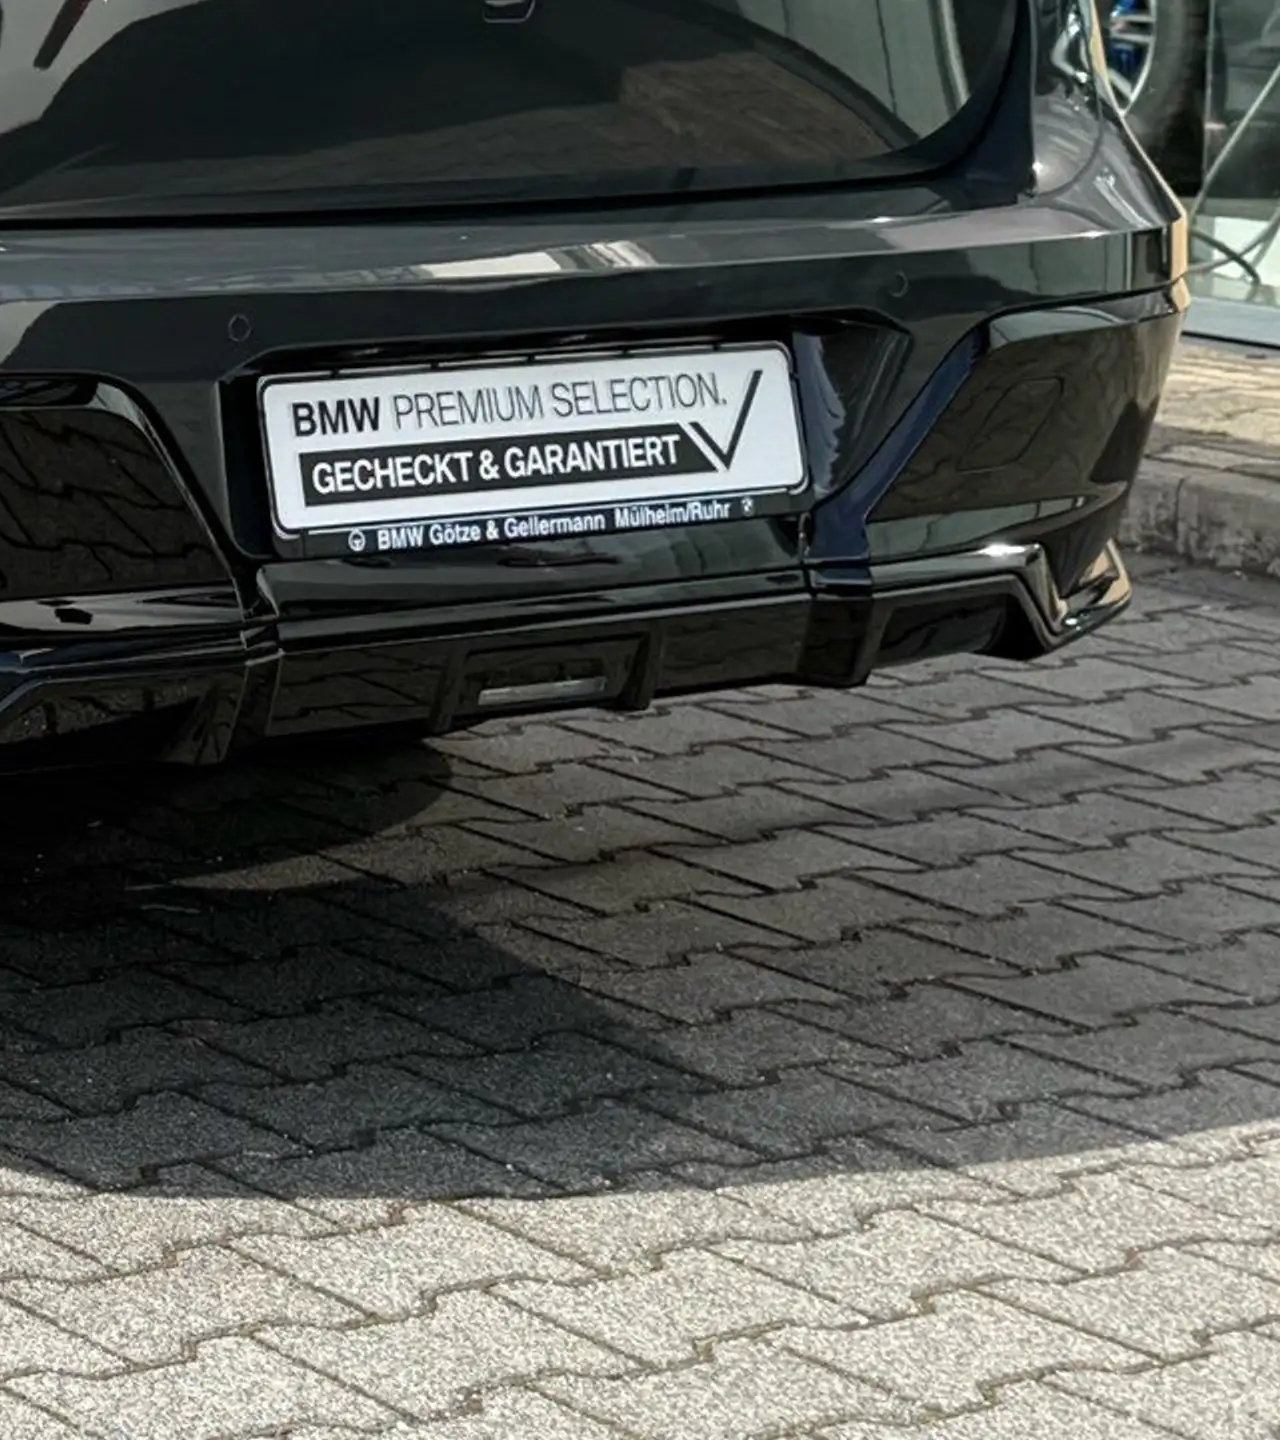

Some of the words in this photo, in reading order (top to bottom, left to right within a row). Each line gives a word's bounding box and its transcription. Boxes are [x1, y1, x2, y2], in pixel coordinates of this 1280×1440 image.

[293, 396, 380, 437] BMW
[393, 385, 545, 430] PREMIUM
[552, 372, 727, 417] SELECTION.
[312, 452, 473, 495] GECHECKT
[479, 450, 500, 481] &
[504, 434, 681, 479] GARANTIERT
[377, 524, 424, 550] BMW
[429, 519, 481, 544] Götze
[486, 518, 500, 540] &
[504, 508, 606, 538] Gellermann
[614, 497, 731, 531] Mülheim/Ruhr
